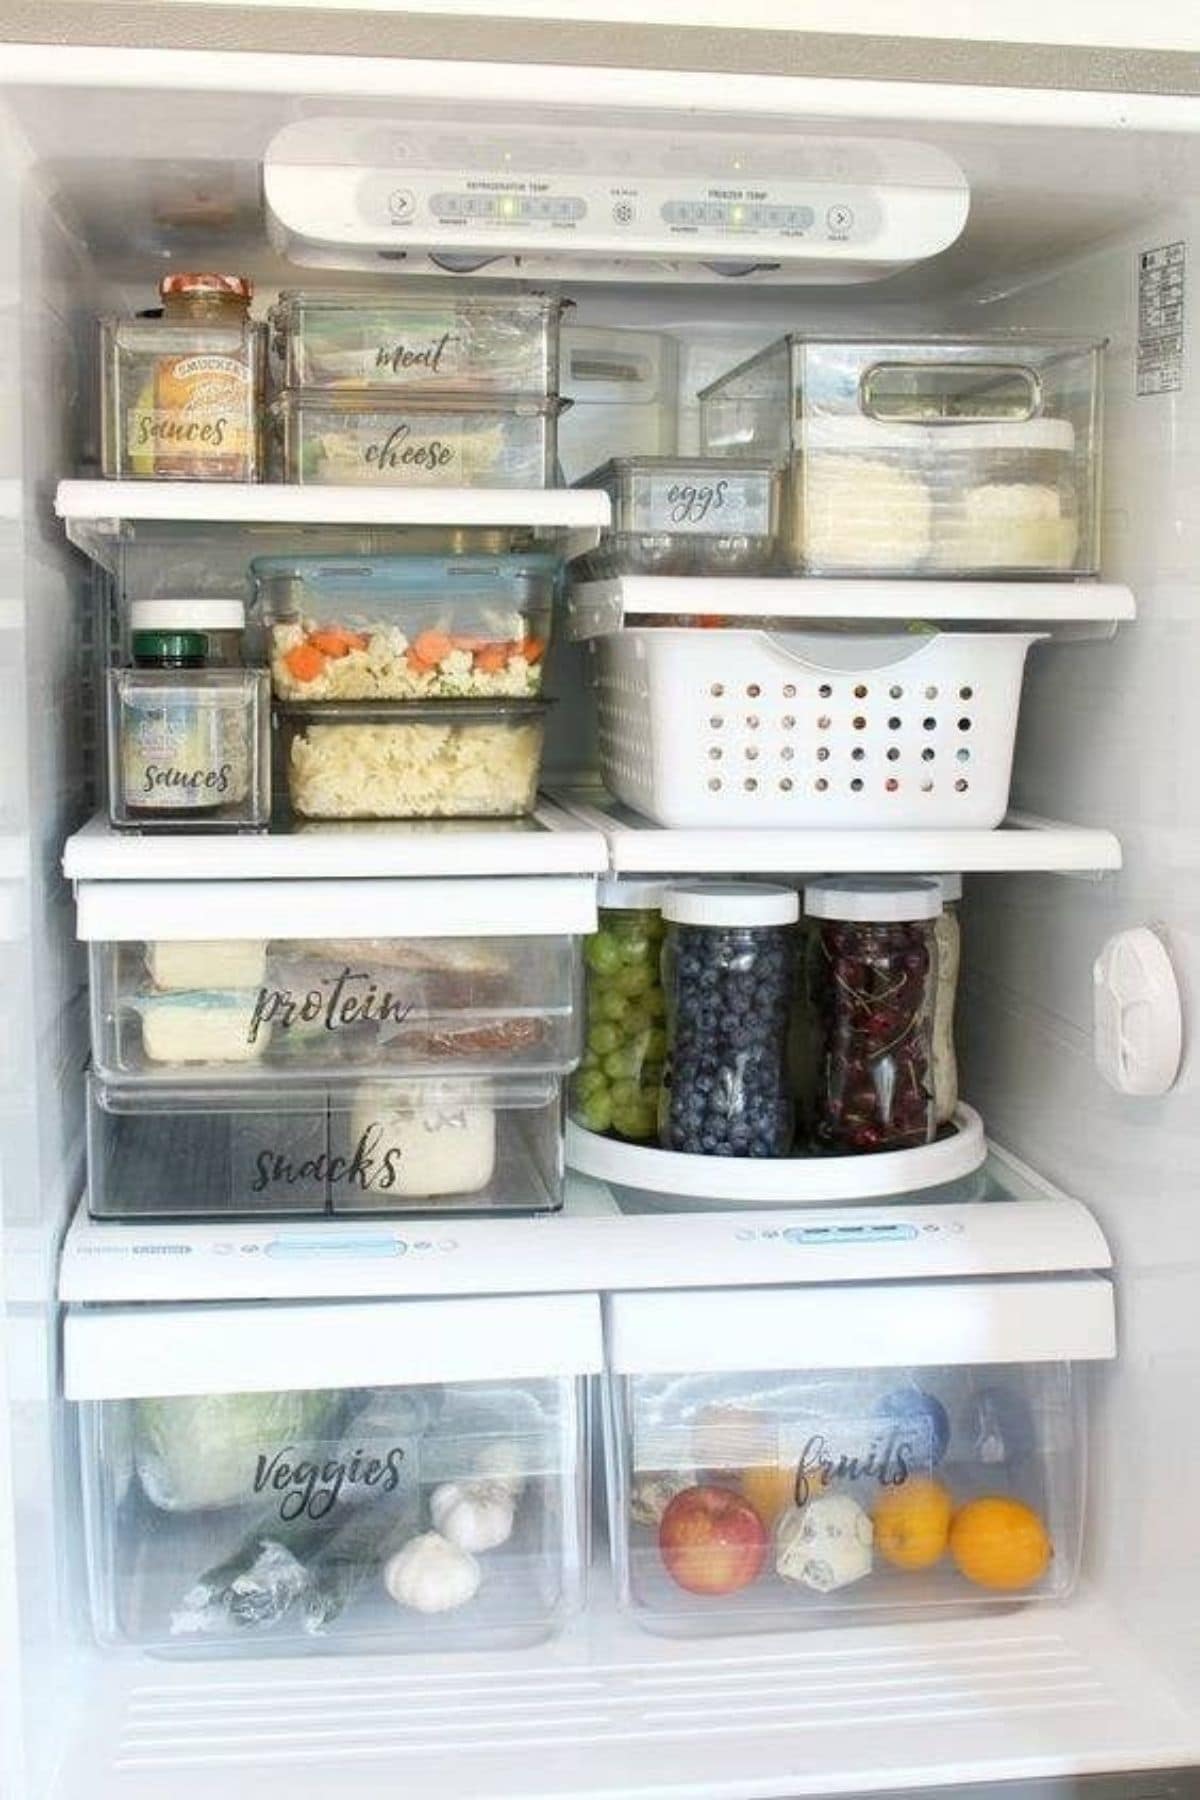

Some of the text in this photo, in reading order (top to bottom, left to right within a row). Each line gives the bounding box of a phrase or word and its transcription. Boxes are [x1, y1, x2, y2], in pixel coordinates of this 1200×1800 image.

[375, 332, 461, 373] meat
[137, 415, 228, 446] sauces
[364, 423, 456, 471] cheese
[666, 479, 729, 524] eggs
[143, 763, 233, 792] sauces
[247, 966, 415, 1044] protein
[251, 1121, 402, 1193] snacks
[794, 1425, 918, 1508] fruits
